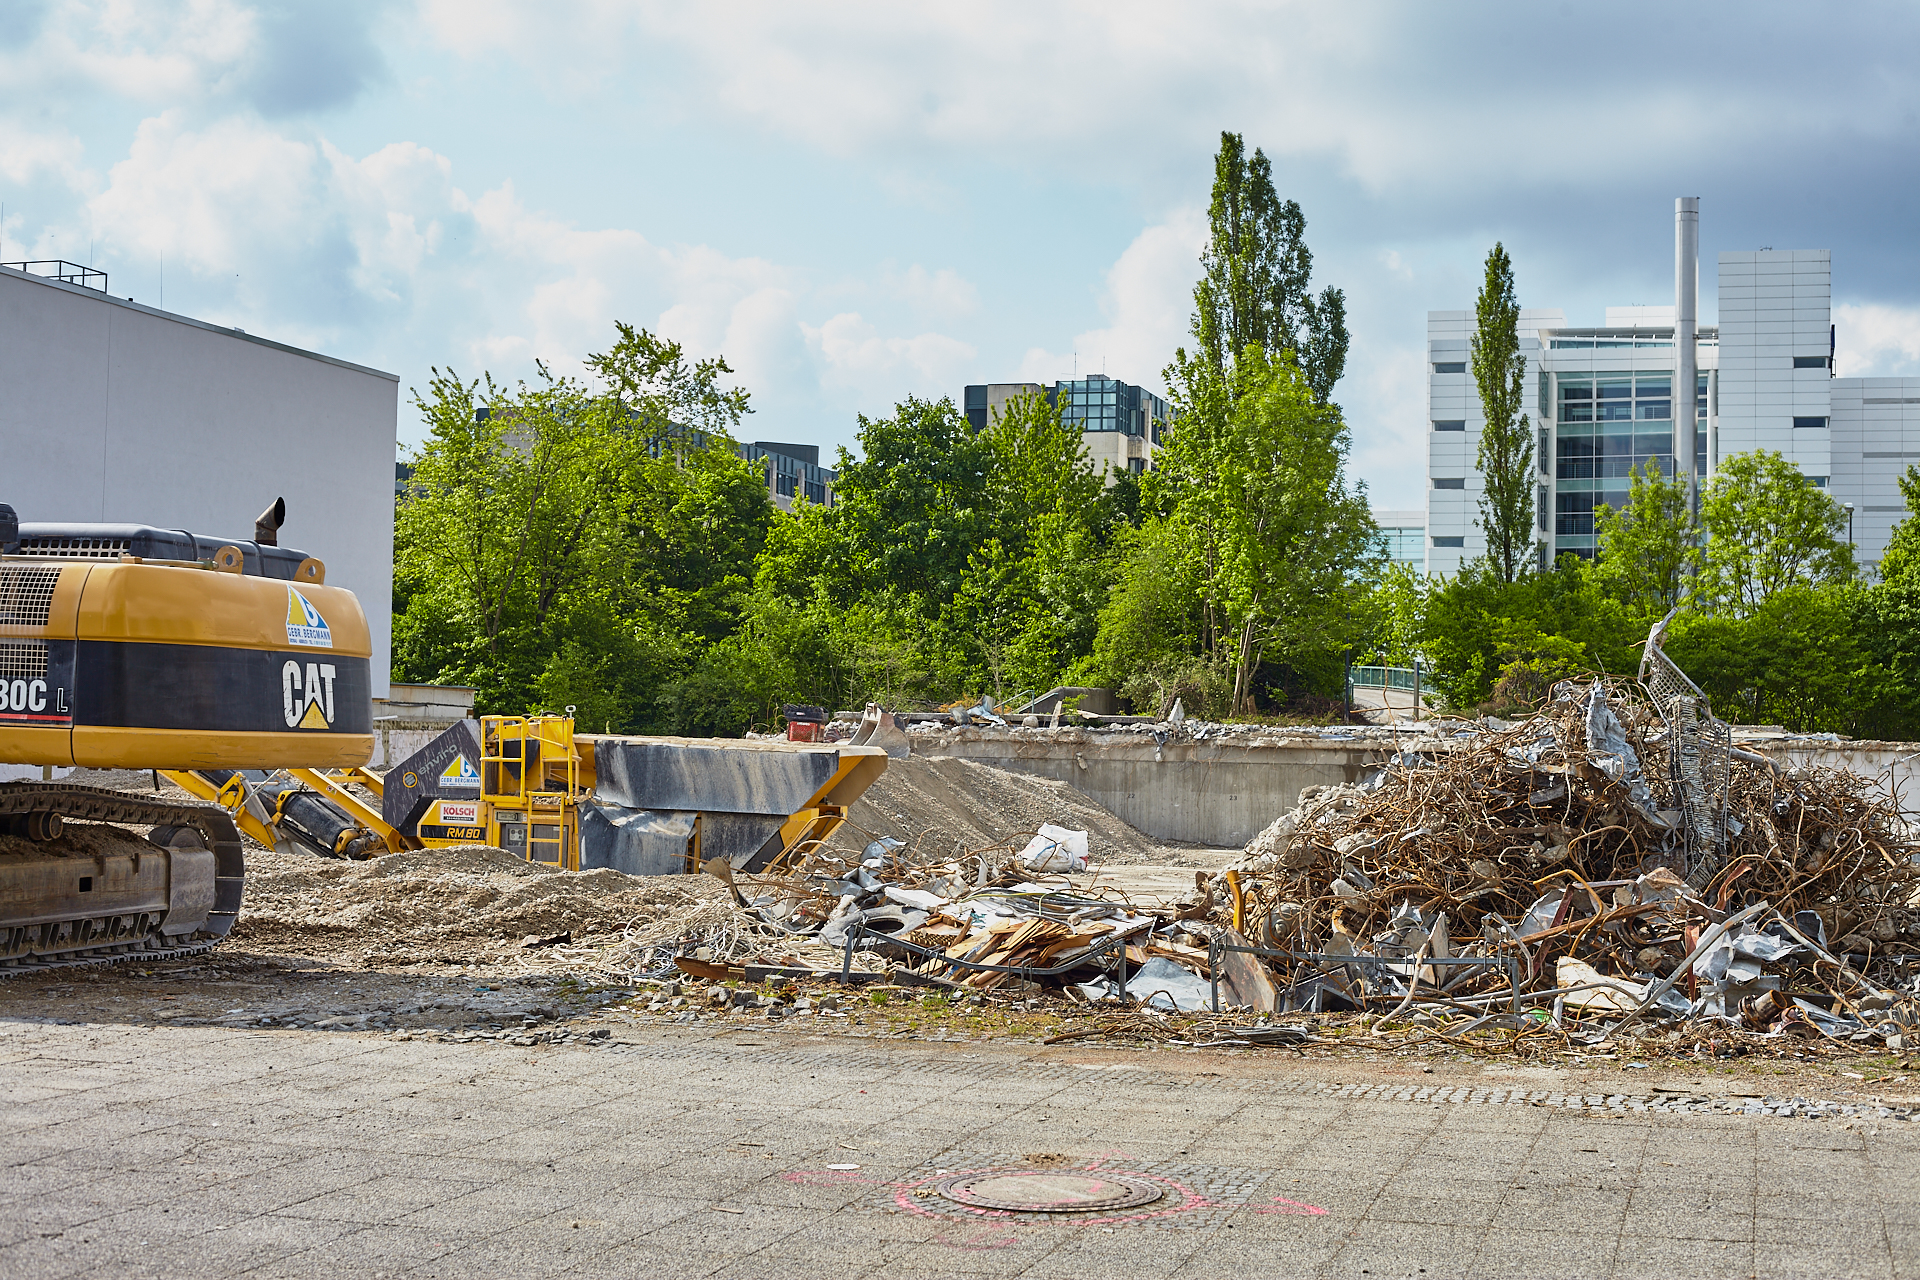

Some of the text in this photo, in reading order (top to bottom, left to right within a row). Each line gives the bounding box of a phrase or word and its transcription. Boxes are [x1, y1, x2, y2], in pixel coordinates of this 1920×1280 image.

[303, 628, 331, 640] BERGMANN
[57, 687, 69, 713] L
[282, 660, 337, 728] CAT
[418, 744, 458, 775] enviro
[446, 827, 481, 839] RM 80
